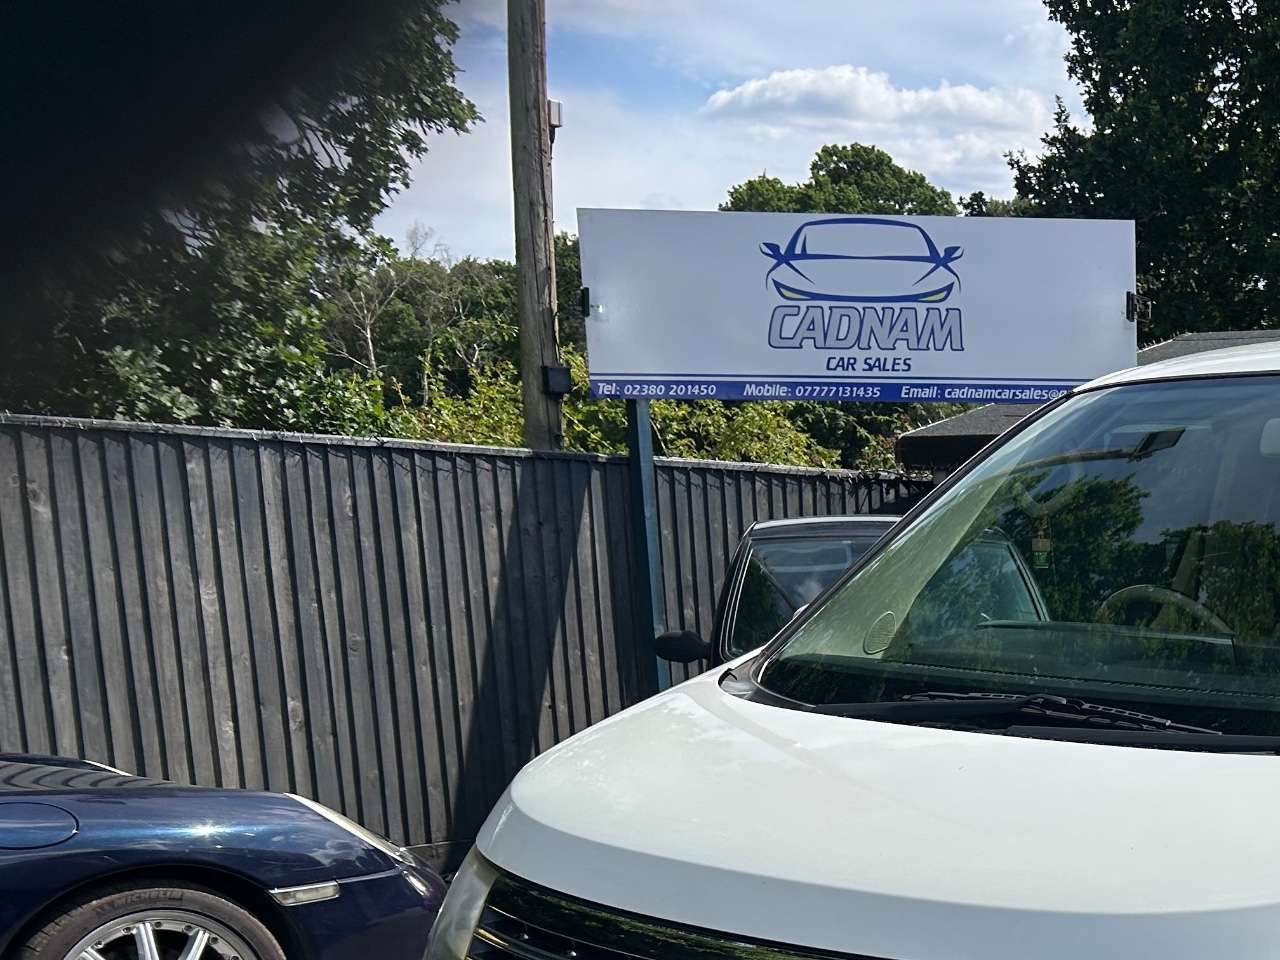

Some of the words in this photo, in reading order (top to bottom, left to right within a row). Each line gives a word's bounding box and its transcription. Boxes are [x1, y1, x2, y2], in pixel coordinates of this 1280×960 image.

[768, 305, 965, 352] CADNAM
[826, 356, 857, 372] CAR
[862, 357, 912, 372] SALES
[598, 383, 620, 395] Tel:
[624, 384, 665, 396] 02380
[669, 384, 717, 396] 201450
[743, 384, 792, 397] Mobile:
[795, 386, 881, 398] 07777131435
[901, 386, 941, 399] Email:
